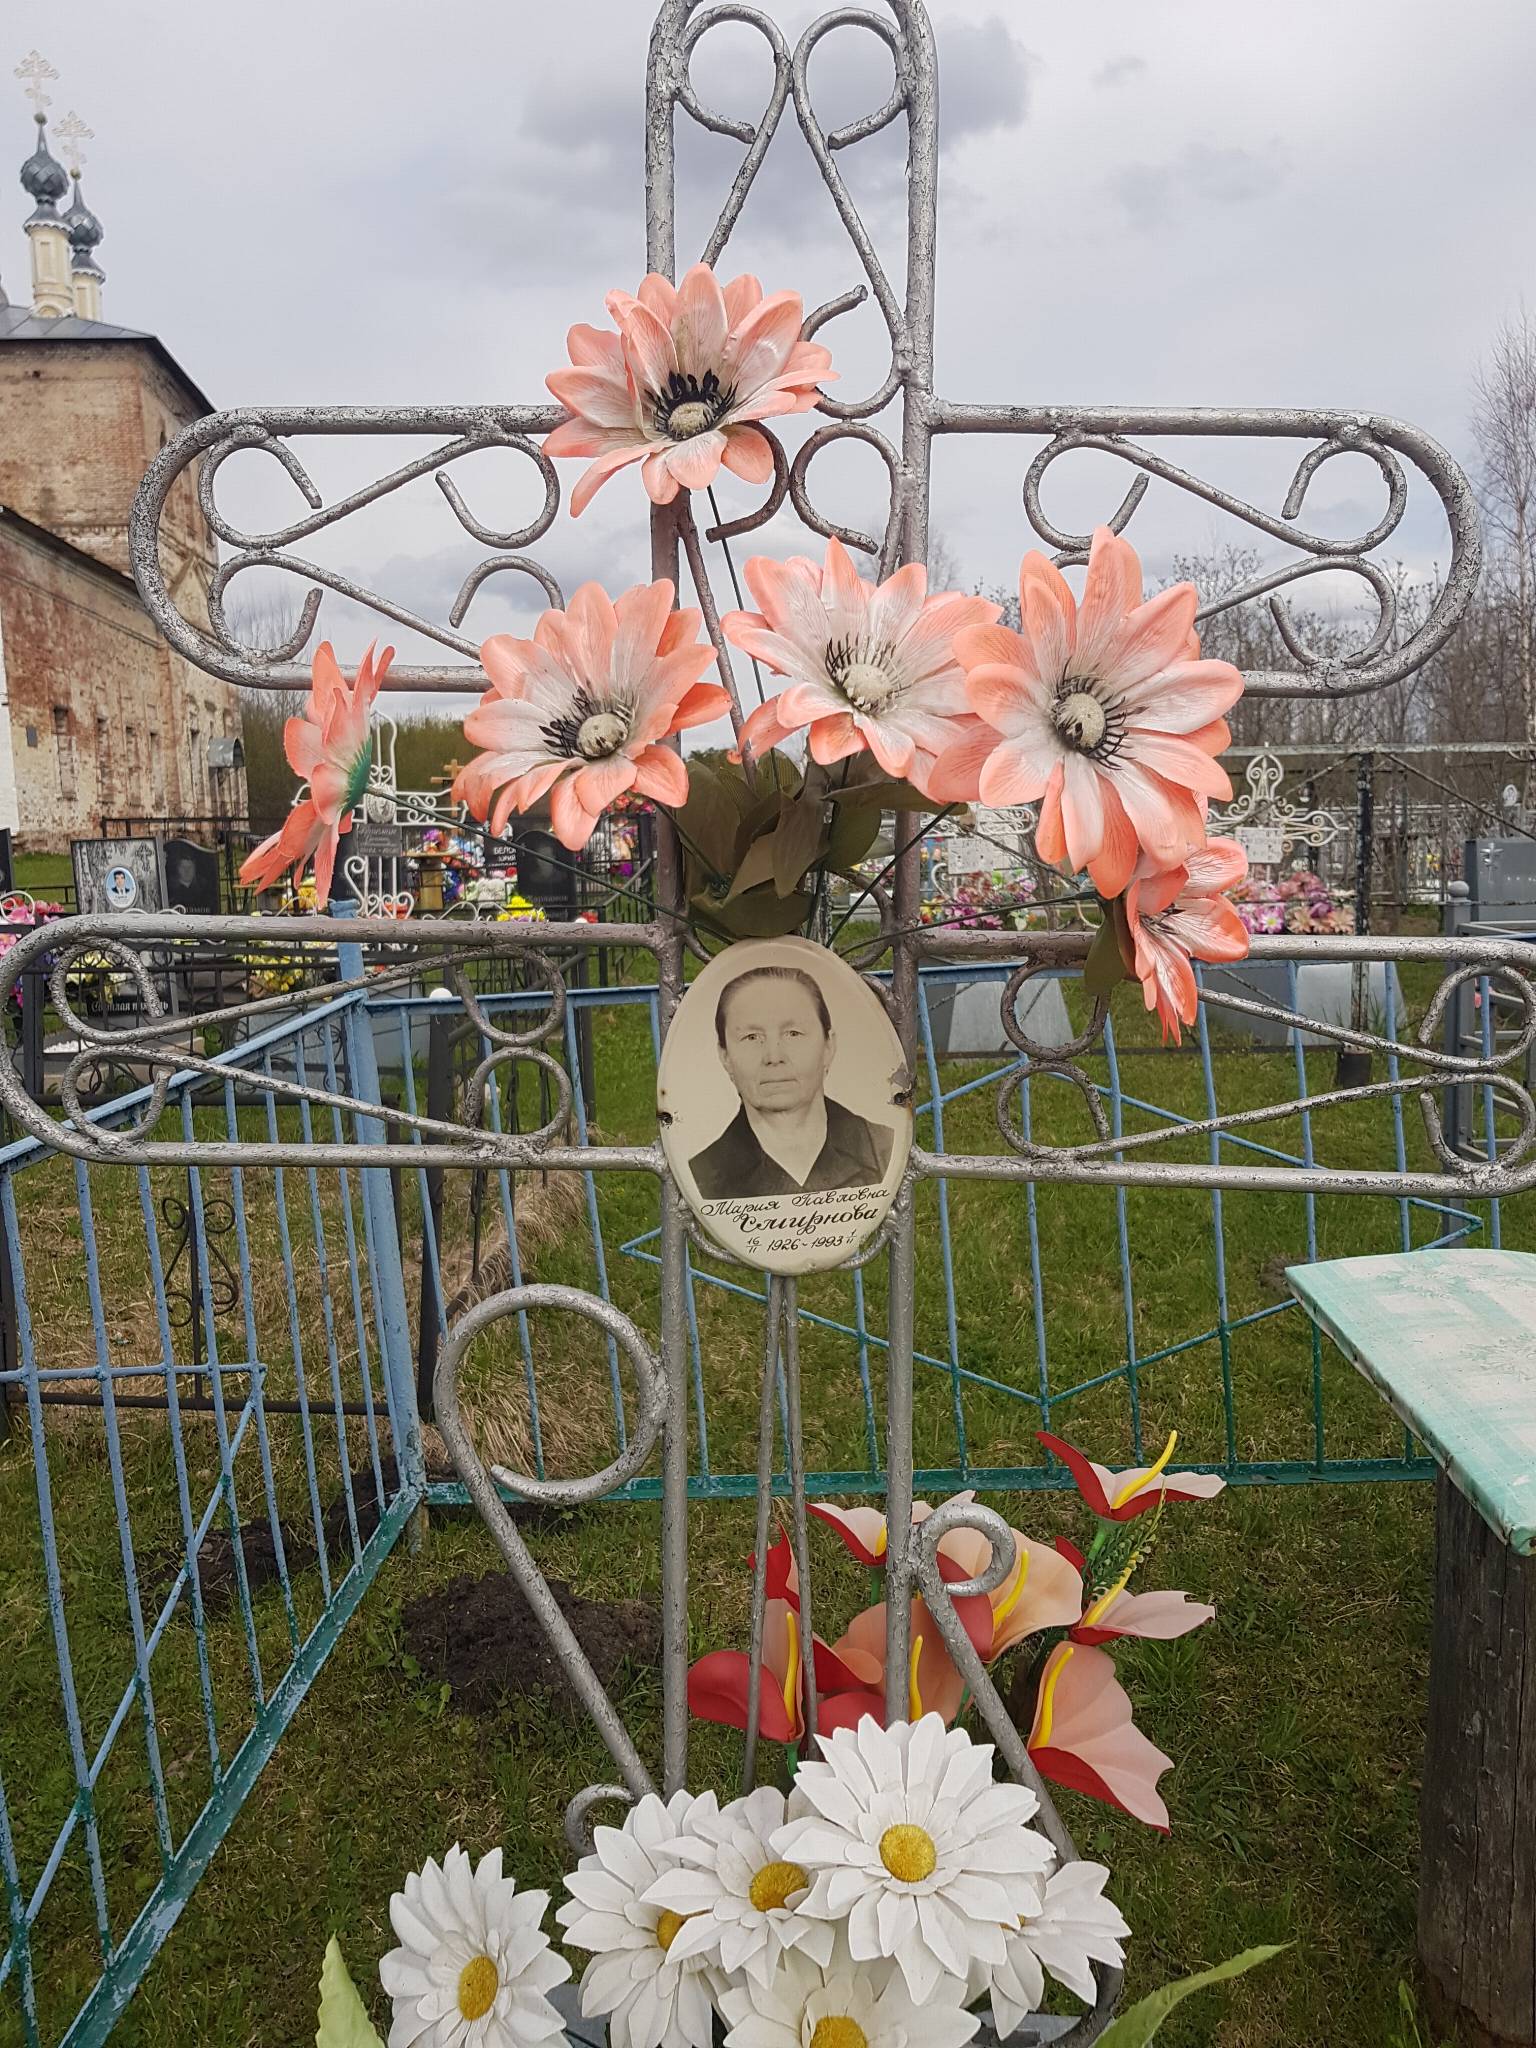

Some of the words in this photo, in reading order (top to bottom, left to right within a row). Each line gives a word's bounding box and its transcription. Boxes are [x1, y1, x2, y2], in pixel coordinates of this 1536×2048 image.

[701, 1201, 781, 1222] Мария
[791, 1188, 890, 1207] Павловна
[740, 1203, 879, 1234] Смирнова
